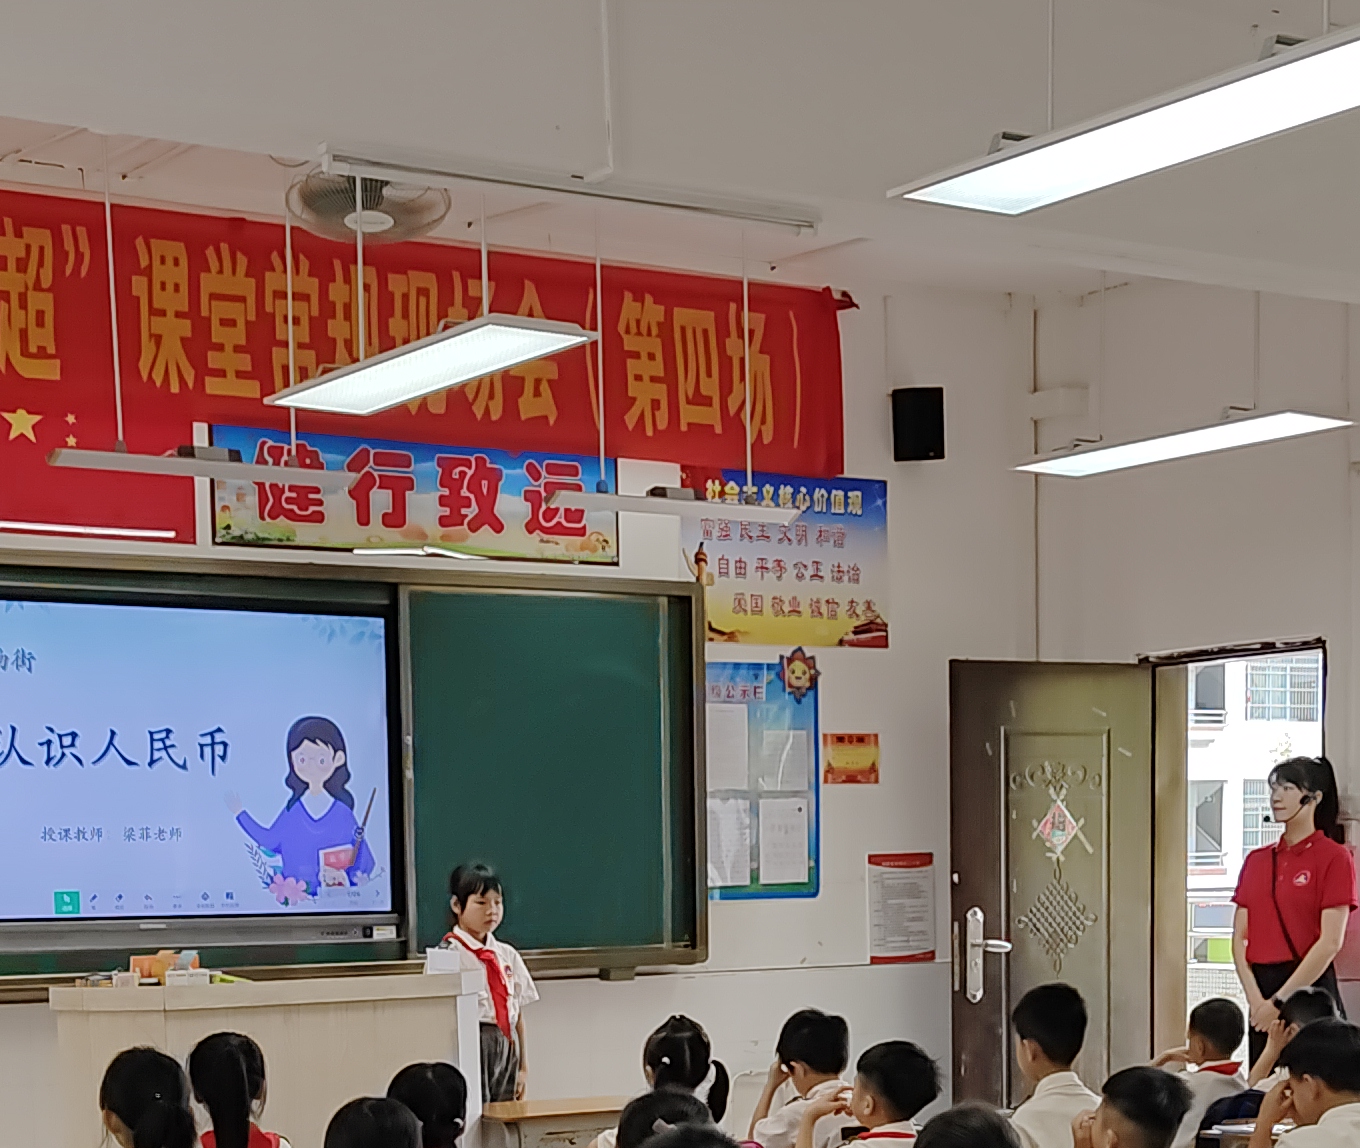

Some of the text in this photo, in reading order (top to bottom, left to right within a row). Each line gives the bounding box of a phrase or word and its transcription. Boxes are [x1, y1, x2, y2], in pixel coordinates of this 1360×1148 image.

[253, 440, 588, 538] 健行致远
[700, 518, 732, 541] 富强
[740, 521, 772, 543] 民主
[777, 522, 809, 547] 文明
[718, 554, 861, 584] 自由 平等 公正 法治
